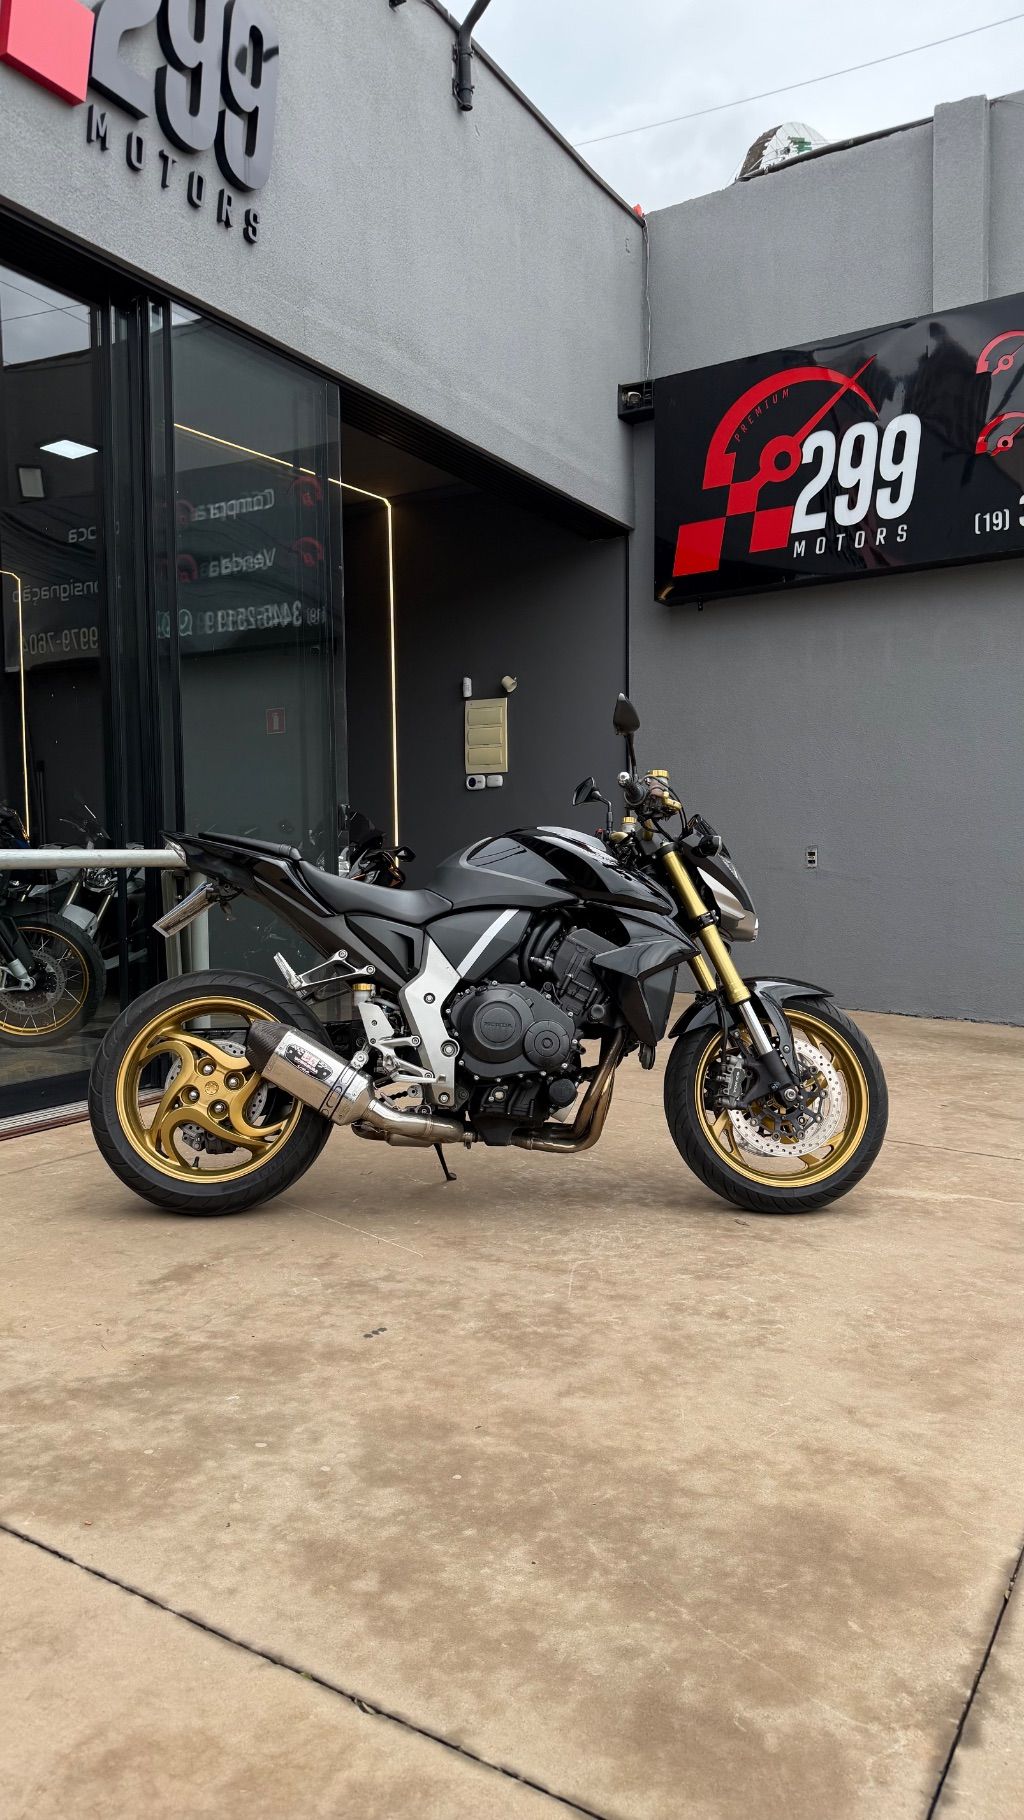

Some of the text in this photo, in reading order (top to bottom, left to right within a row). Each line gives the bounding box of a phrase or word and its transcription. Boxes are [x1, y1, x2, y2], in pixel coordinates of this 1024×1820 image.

[87, 104, 260, 243] MOTORS
[734, 388, 789, 443] PREMIUM
[791, 413, 922, 534] 299
[793, 524, 908, 558] MOTORS
[975, 508, 1010, 535] (19)
